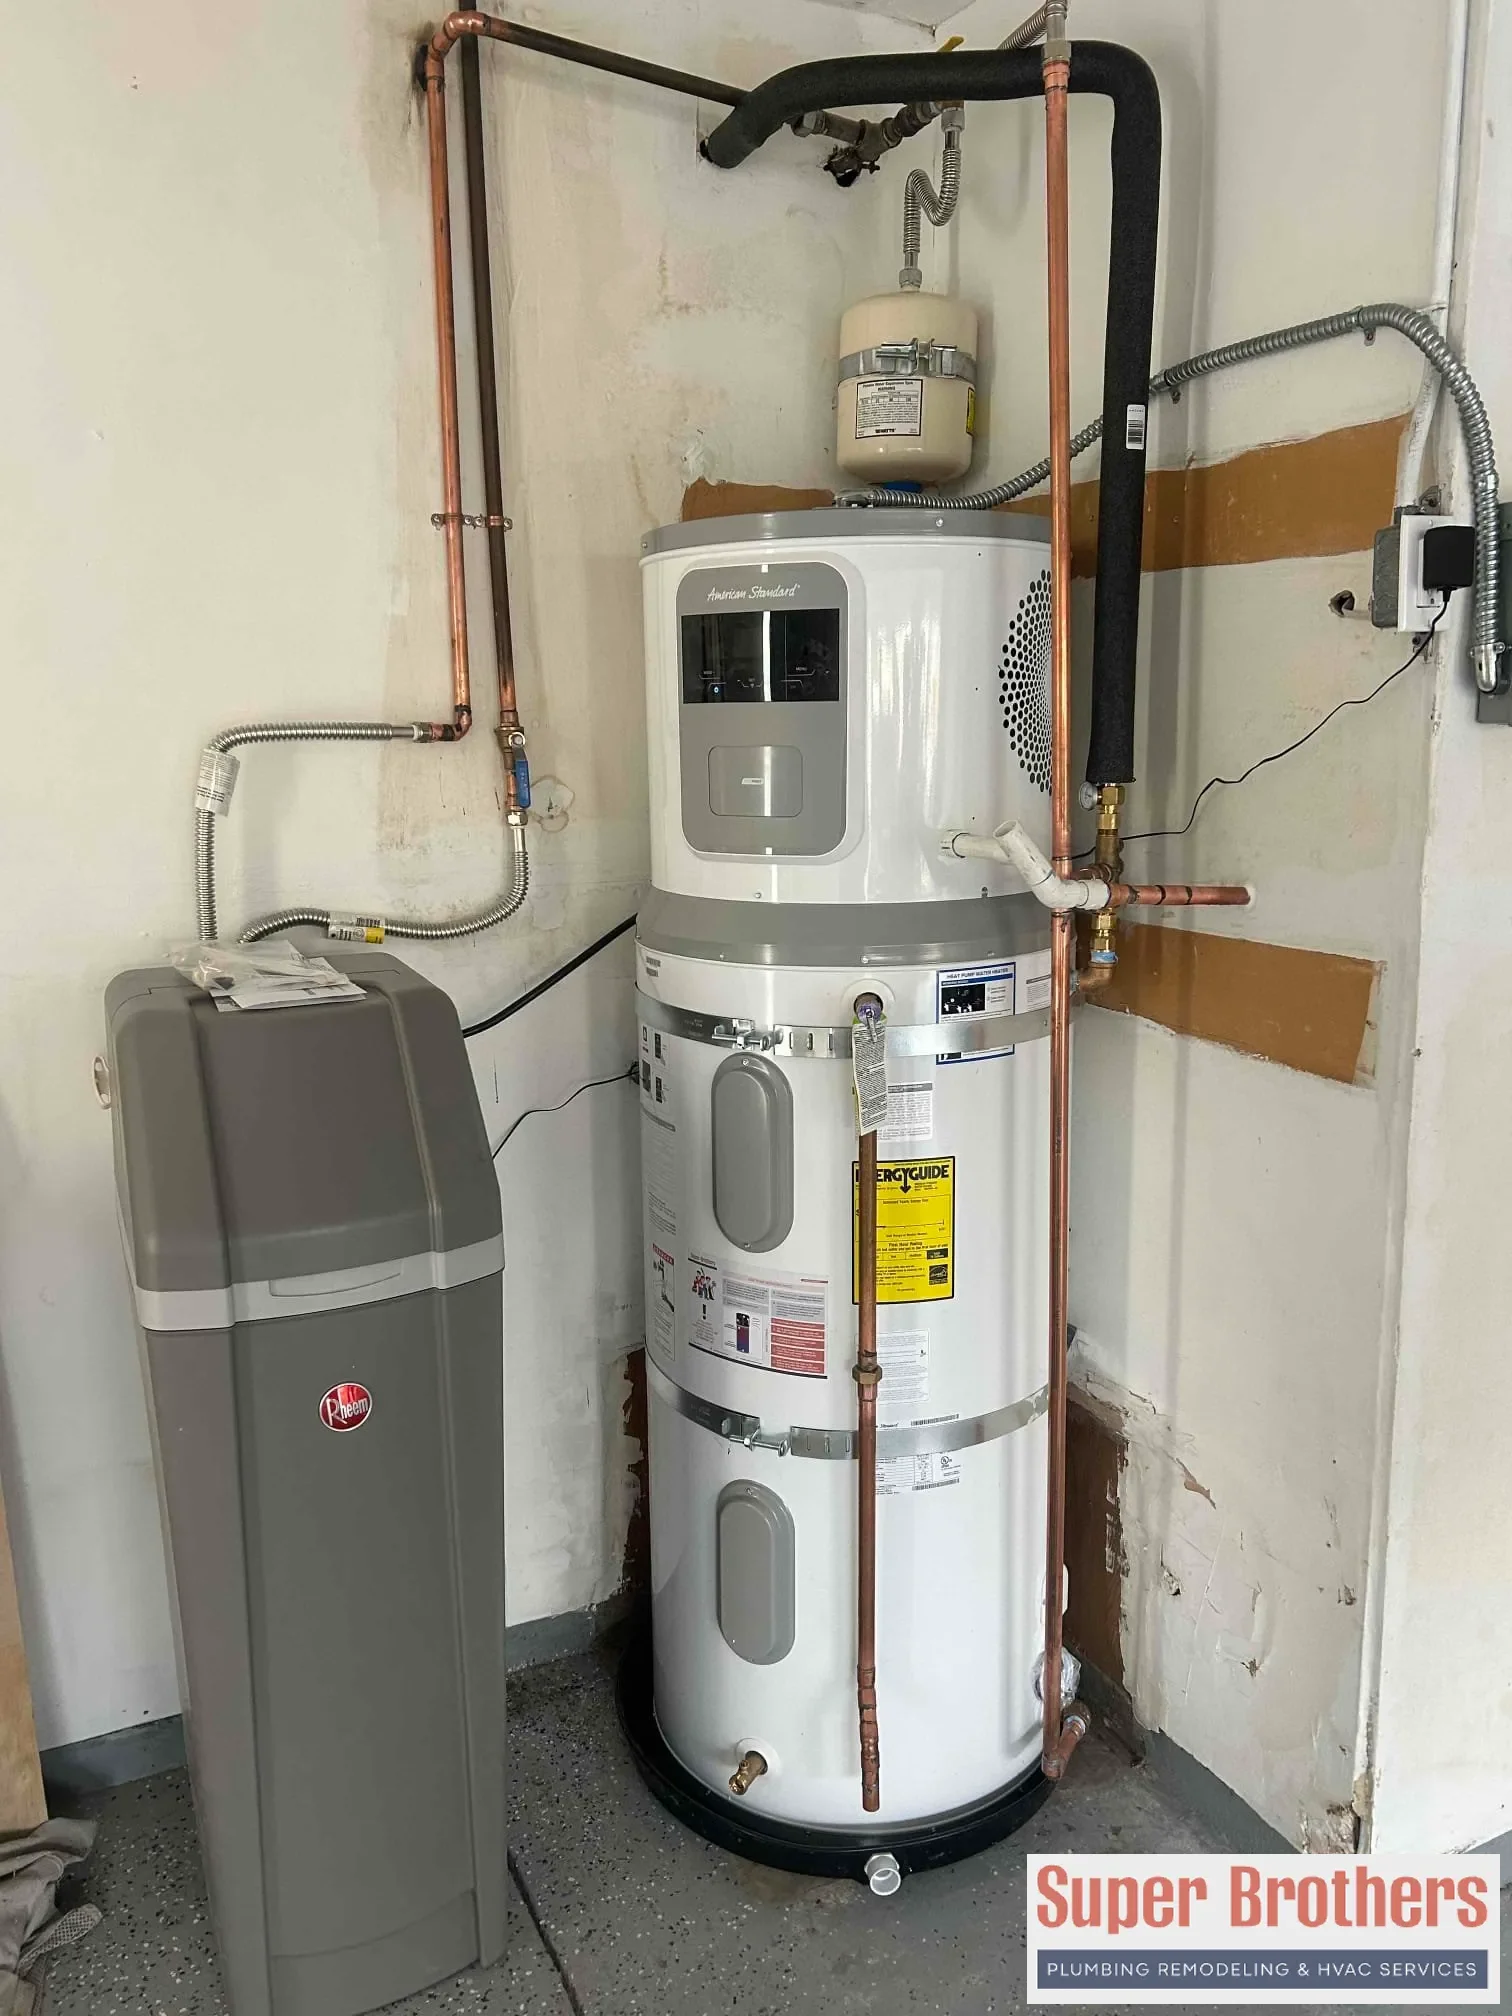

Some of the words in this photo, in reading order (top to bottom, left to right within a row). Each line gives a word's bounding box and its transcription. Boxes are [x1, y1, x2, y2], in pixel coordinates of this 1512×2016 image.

[707, 587, 747, 602] American
[748, 584, 797, 600] Standard
[855, 1164, 950, 1184] ERGYGUIDE
[325, 1387, 369, 1427] Rheem
